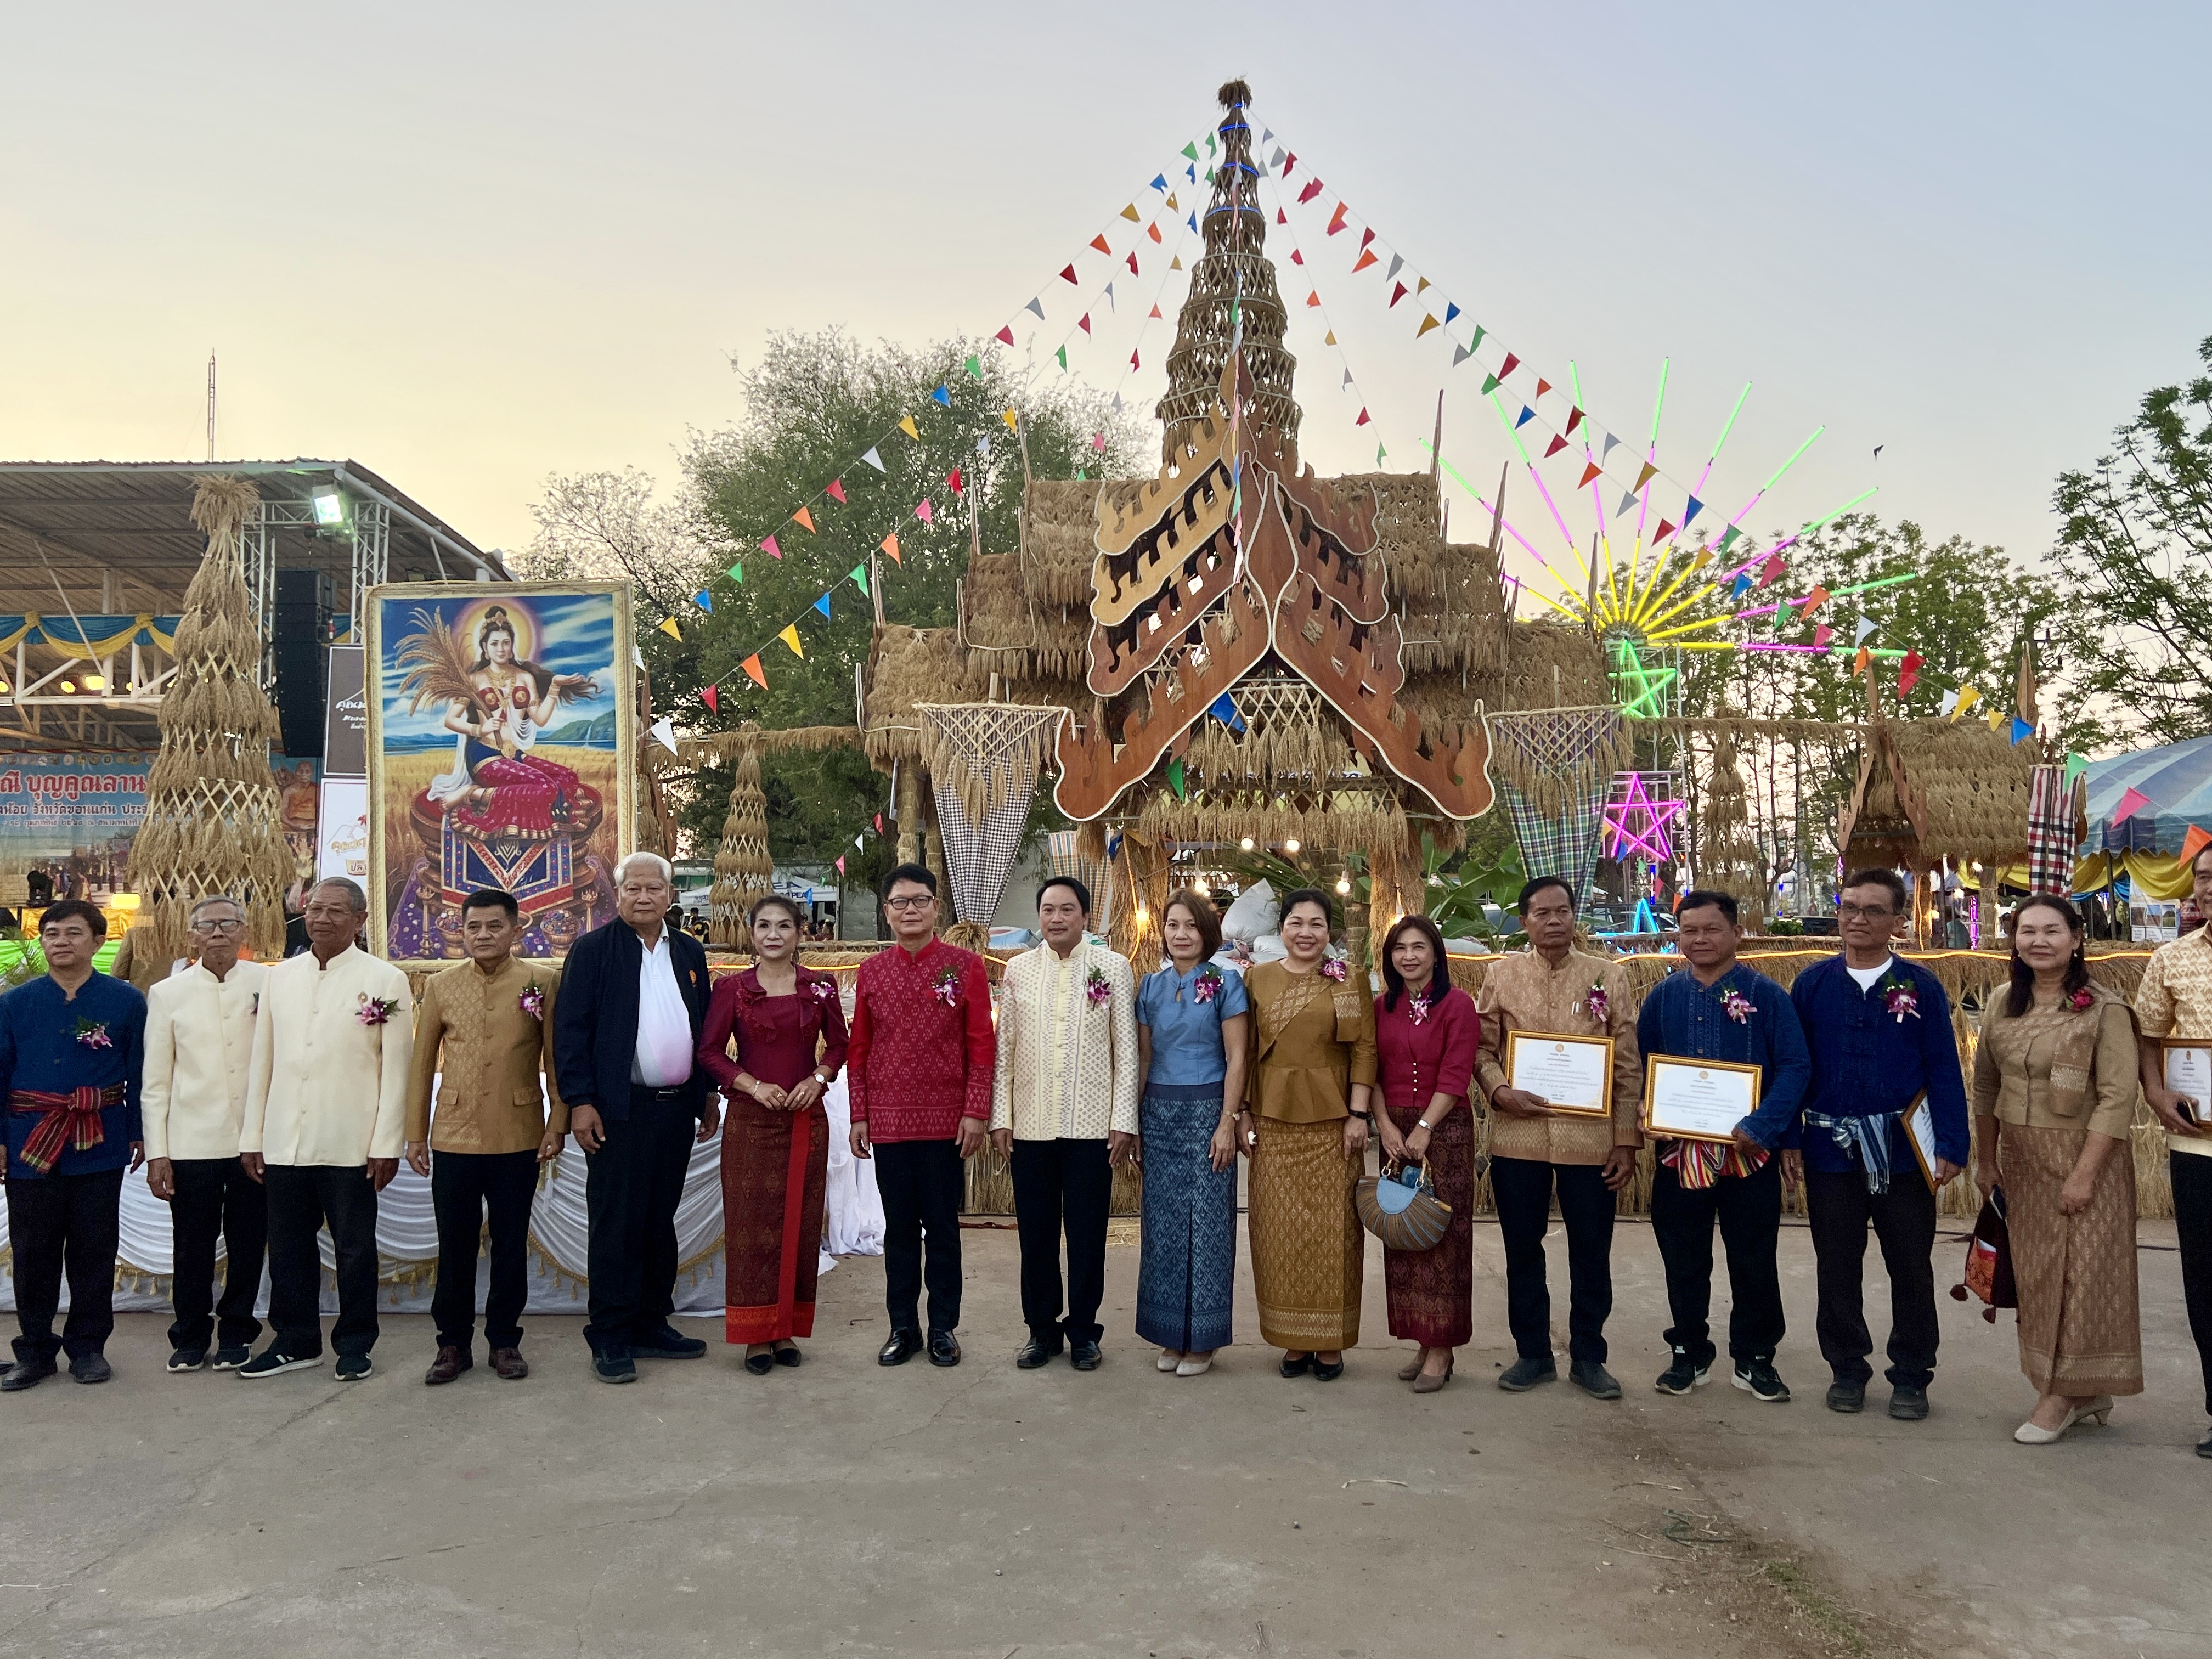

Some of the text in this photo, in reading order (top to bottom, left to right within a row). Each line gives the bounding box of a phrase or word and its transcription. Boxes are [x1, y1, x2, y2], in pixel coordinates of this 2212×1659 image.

[26, 774, 147, 800] บุญคูณลาน
[33, 801, 116, 815] จังหวัดขอนแก่น
